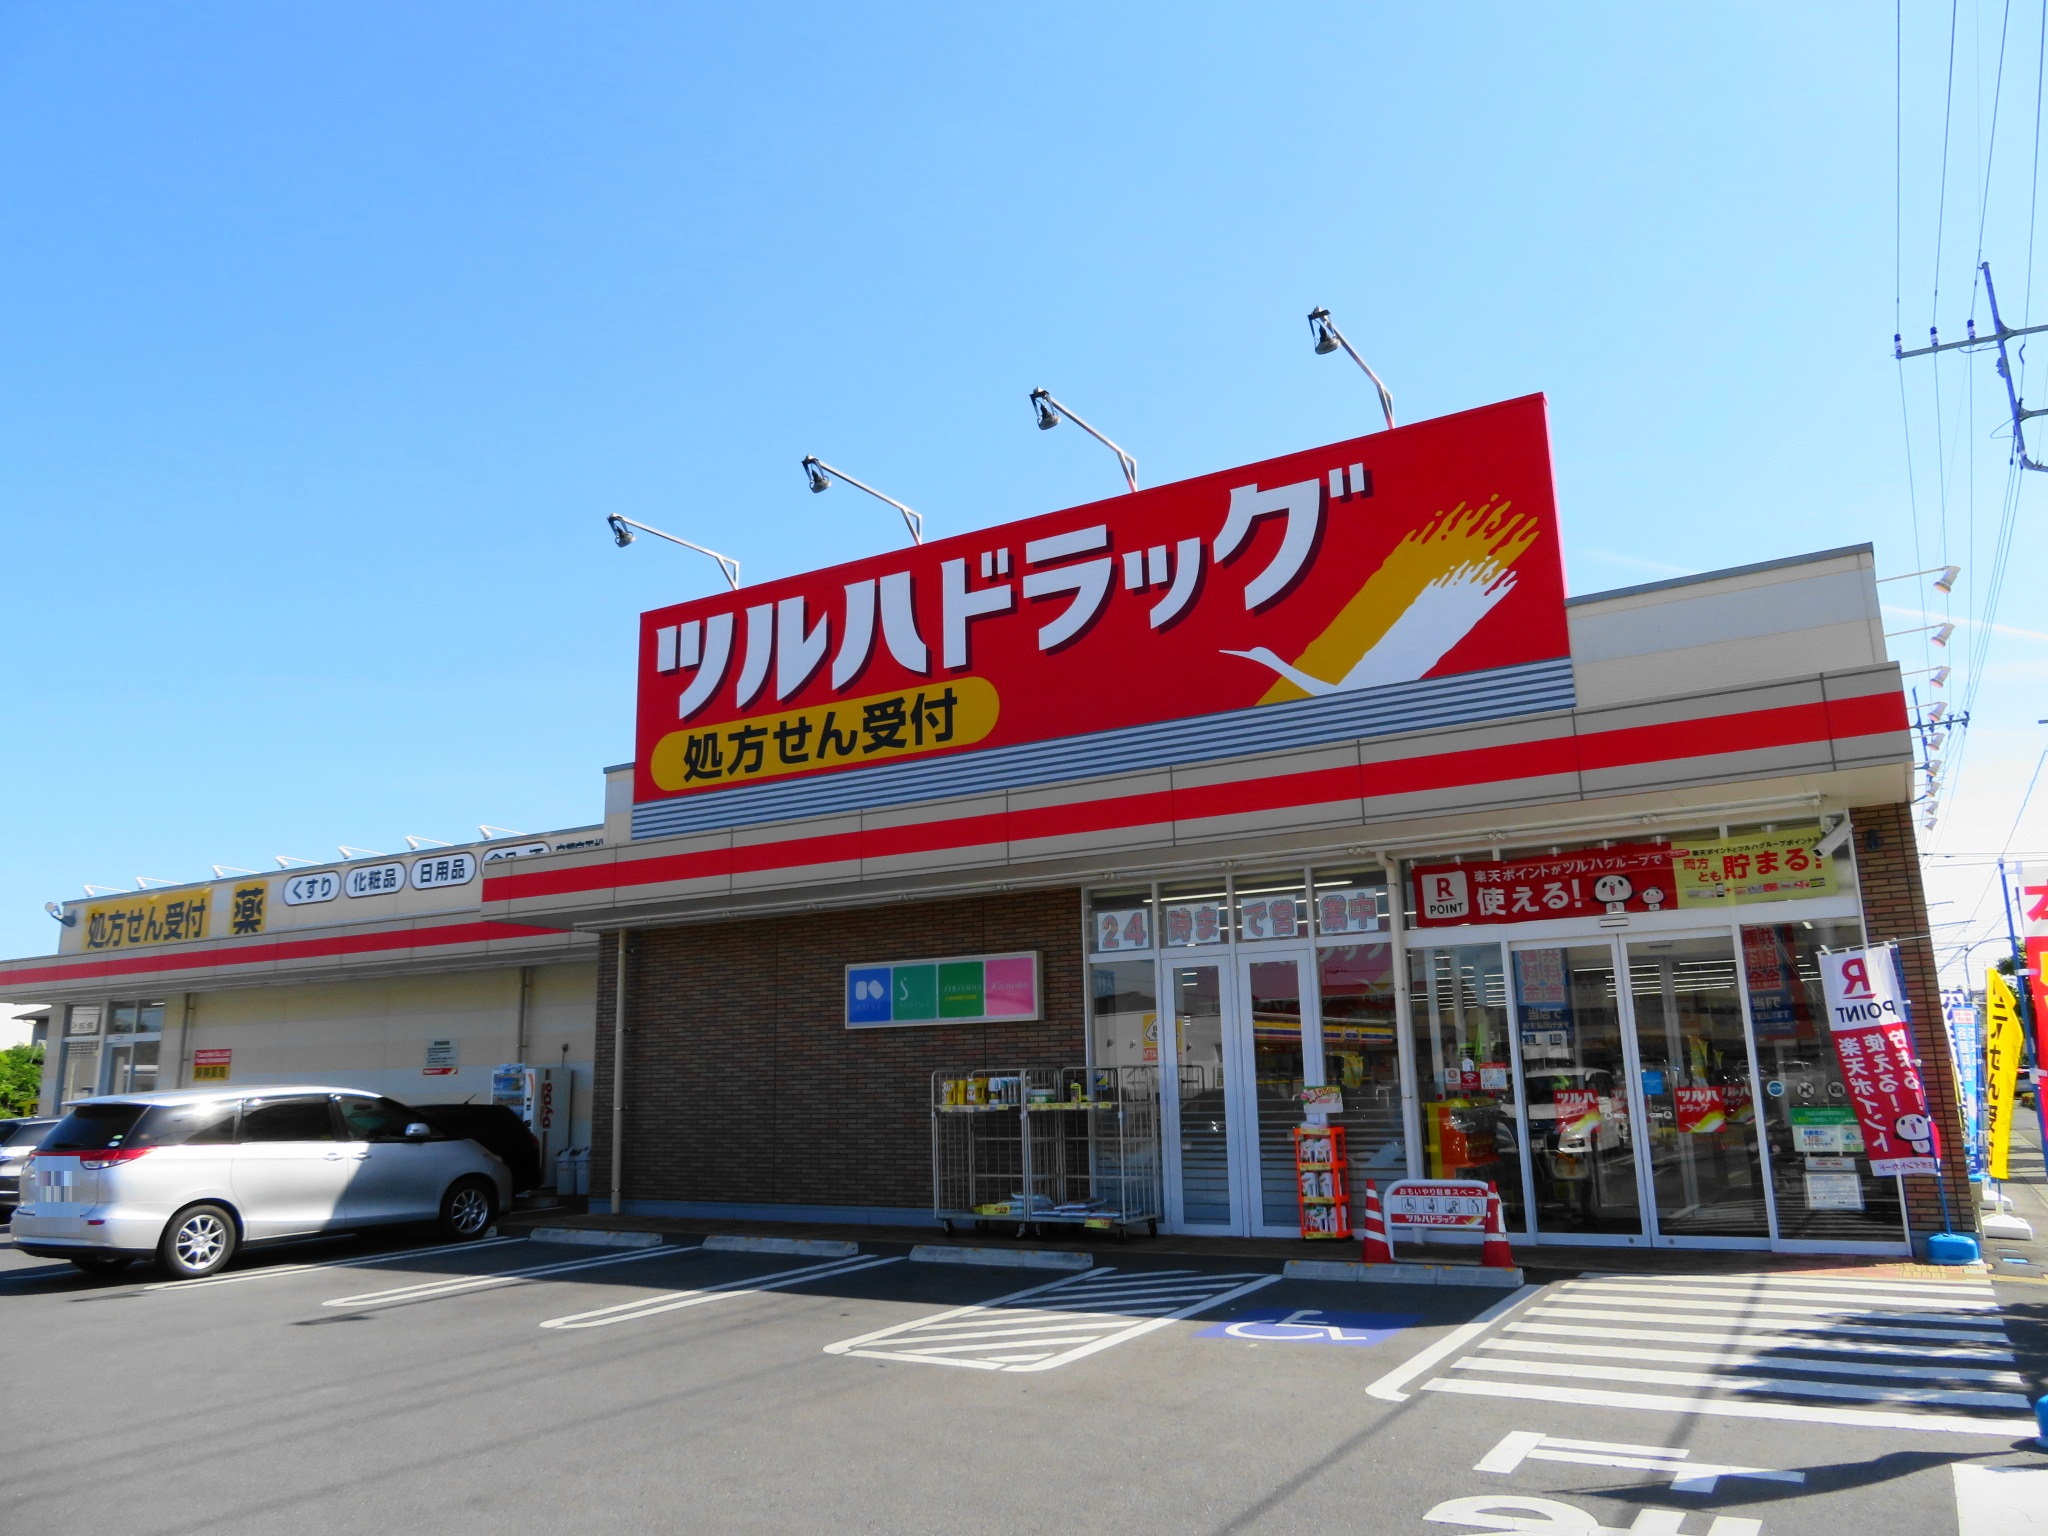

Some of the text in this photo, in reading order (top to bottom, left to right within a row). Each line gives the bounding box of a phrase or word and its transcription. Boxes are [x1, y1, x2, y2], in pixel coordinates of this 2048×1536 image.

[656, 462, 1369, 718] ツルハドラッグ
[682, 687, 958, 782] 処方せん受付
[419, 859, 465, 884] 日用品
[1683, 858, 1710, 871] 両方
[292, 879, 333, 900] くすり
[354, 868, 397, 893] 化粧品
[1436, 878, 1454, 898] R
[1476, 879, 1582, 916] 使える!
[233, 887, 265, 934] 薬
[1430, 901, 1464, 915] POINT
[87, 898, 206, 949] 処方せん受付
[1557, 1092, 1595, 1104] ツルハ
[1678, 1090, 1720, 1102] ツルハ
[1679, 1103, 1711, 1113] ドラッグ
[1400, 1187, 1483, 1197] おもいやり駐車スペース
[1406, 1214, 1458, 1224] ツルハドラッグ
